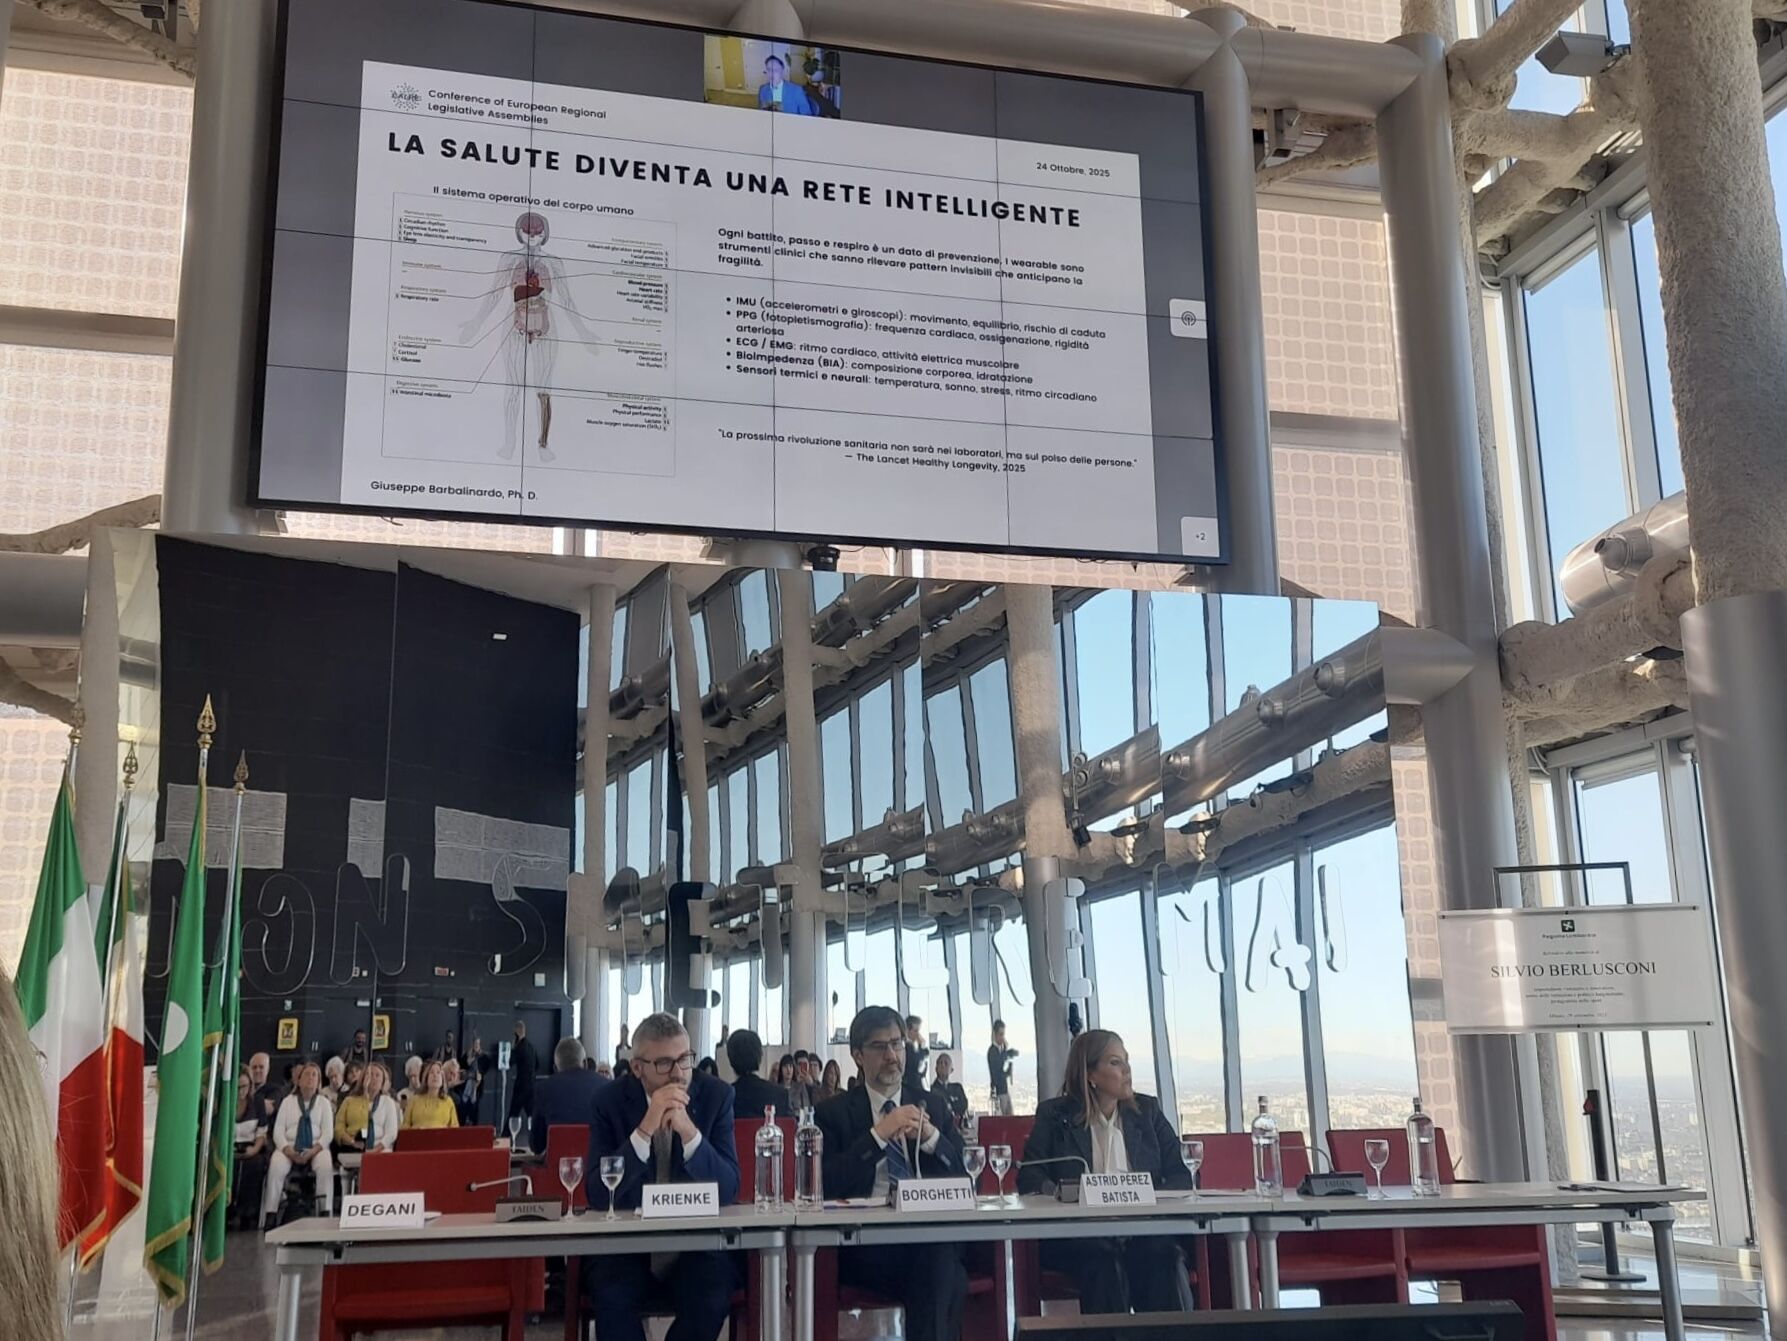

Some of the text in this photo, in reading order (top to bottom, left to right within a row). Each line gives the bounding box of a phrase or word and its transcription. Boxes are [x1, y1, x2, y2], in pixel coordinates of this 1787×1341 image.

[428, 102, 548, 124] Legislative Assemblies
[429, 89, 606, 119] Conference of European Regional
[389, 132, 1079, 227] LA SALUTE DIVENTA UNA RETE INTELLIGENTE
[1037, 162, 1110, 177] 24 Ottobre, 2025
[434, 186, 634, 215] Il sistema operativo del corpo umano
[718, 228, 743, 240] Ogni
[747, 230, 785, 244] battito,
[789, 237, 820, 246] passo
[833, 241, 869, 252] respiro
[872, 244, 879, 252] è
[898, 247, 922, 257] dato
[925, 250, 934, 258] di
[1011, 260, 1057, 270] wearable
[1061, 264, 1084, 272] sono
[718, 254, 763, 267] fragilità.
[719, 242, 771, 254] strumenti
[775, 248, 805, 258] clinici
[809, 251, 828, 260] che
[832, 254, 864, 264] sanno
[867, 256, 906, 268] rilevare
[910, 262, 947, 272] pattern
[951, 264, 992, 276] invisibili
[1017, 272, 1070, 284] anticipano
[1074, 277, 1083, 285] la
[737, 297, 756, 307] IMU
[760, 296, 838, 314] (accelerometri
[851, 308, 906, 322] giroscopi):
[910, 314, 970, 327] movimento,
[973, 320, 1021, 332] equilibrio,
[1024, 324, 1056, 334] rischio
[1059, 327, 1068, 335] di
[1071, 329, 1106, 338] caduta
[736, 310, 1089, 350] PPG (fotopletismografia): frequenza cardiaca, ossigenazione, rigidità
[736, 325, 784, 336] arteriosa
[736, 337, 1019, 369] ECG / EMG: ritmo cardiaco, attività elettrica muscolare
[818, 357, 847, 370] (BIA):
[851, 362, 922, 375] composizione
[926, 369, 973, 380] corporea,
[977, 371, 1033, 384] idratazione
[736, 364, 776, 376] Sensori
[780, 368, 818, 380] termici
[832, 374, 870, 383] neurali:
[875, 376, 942, 391] temperatura,
[945, 383, 977, 393] sonno,
[981, 386, 1012, 396] stress,
[1016, 388, 1041, 398] ritmo
[1045, 391, 1097, 402] circadiano
[736, 432, 784, 442] prossima
[788, 435, 841, 447] rivoluzione
[845, 440, 888, 450] sanitaria
[913, 445, 934, 454] sarà
[955, 447, 1004, 459] laboratori,
[1042, 454, 1067, 463] polso
[1069, 456, 1092, 464] delle
[857, 453, 874, 462] The
[877, 455, 909, 465] Lancet
[913, 457, 949, 470] Healthy
[952, 460, 1000, 472] Longevity,
[1003, 463, 1025, 472] 2025
[371, 481, 425, 494] Giuseppe
[429, 485, 504, 499] Barbalinardo,
[528, 491, 538, 500] D.
[1491, 962, 1657, 978] SILVIO BERLUSCONI
[1086, 1176, 1118, 1186] ASTRID
[652, 1192, 711, 1205] KRIENKE
[902, 1187, 971, 1201] BORGHETTI
[1102, 1191, 1140, 1203] BATISTA
[348, 1202, 415, 1216] DEGANI
